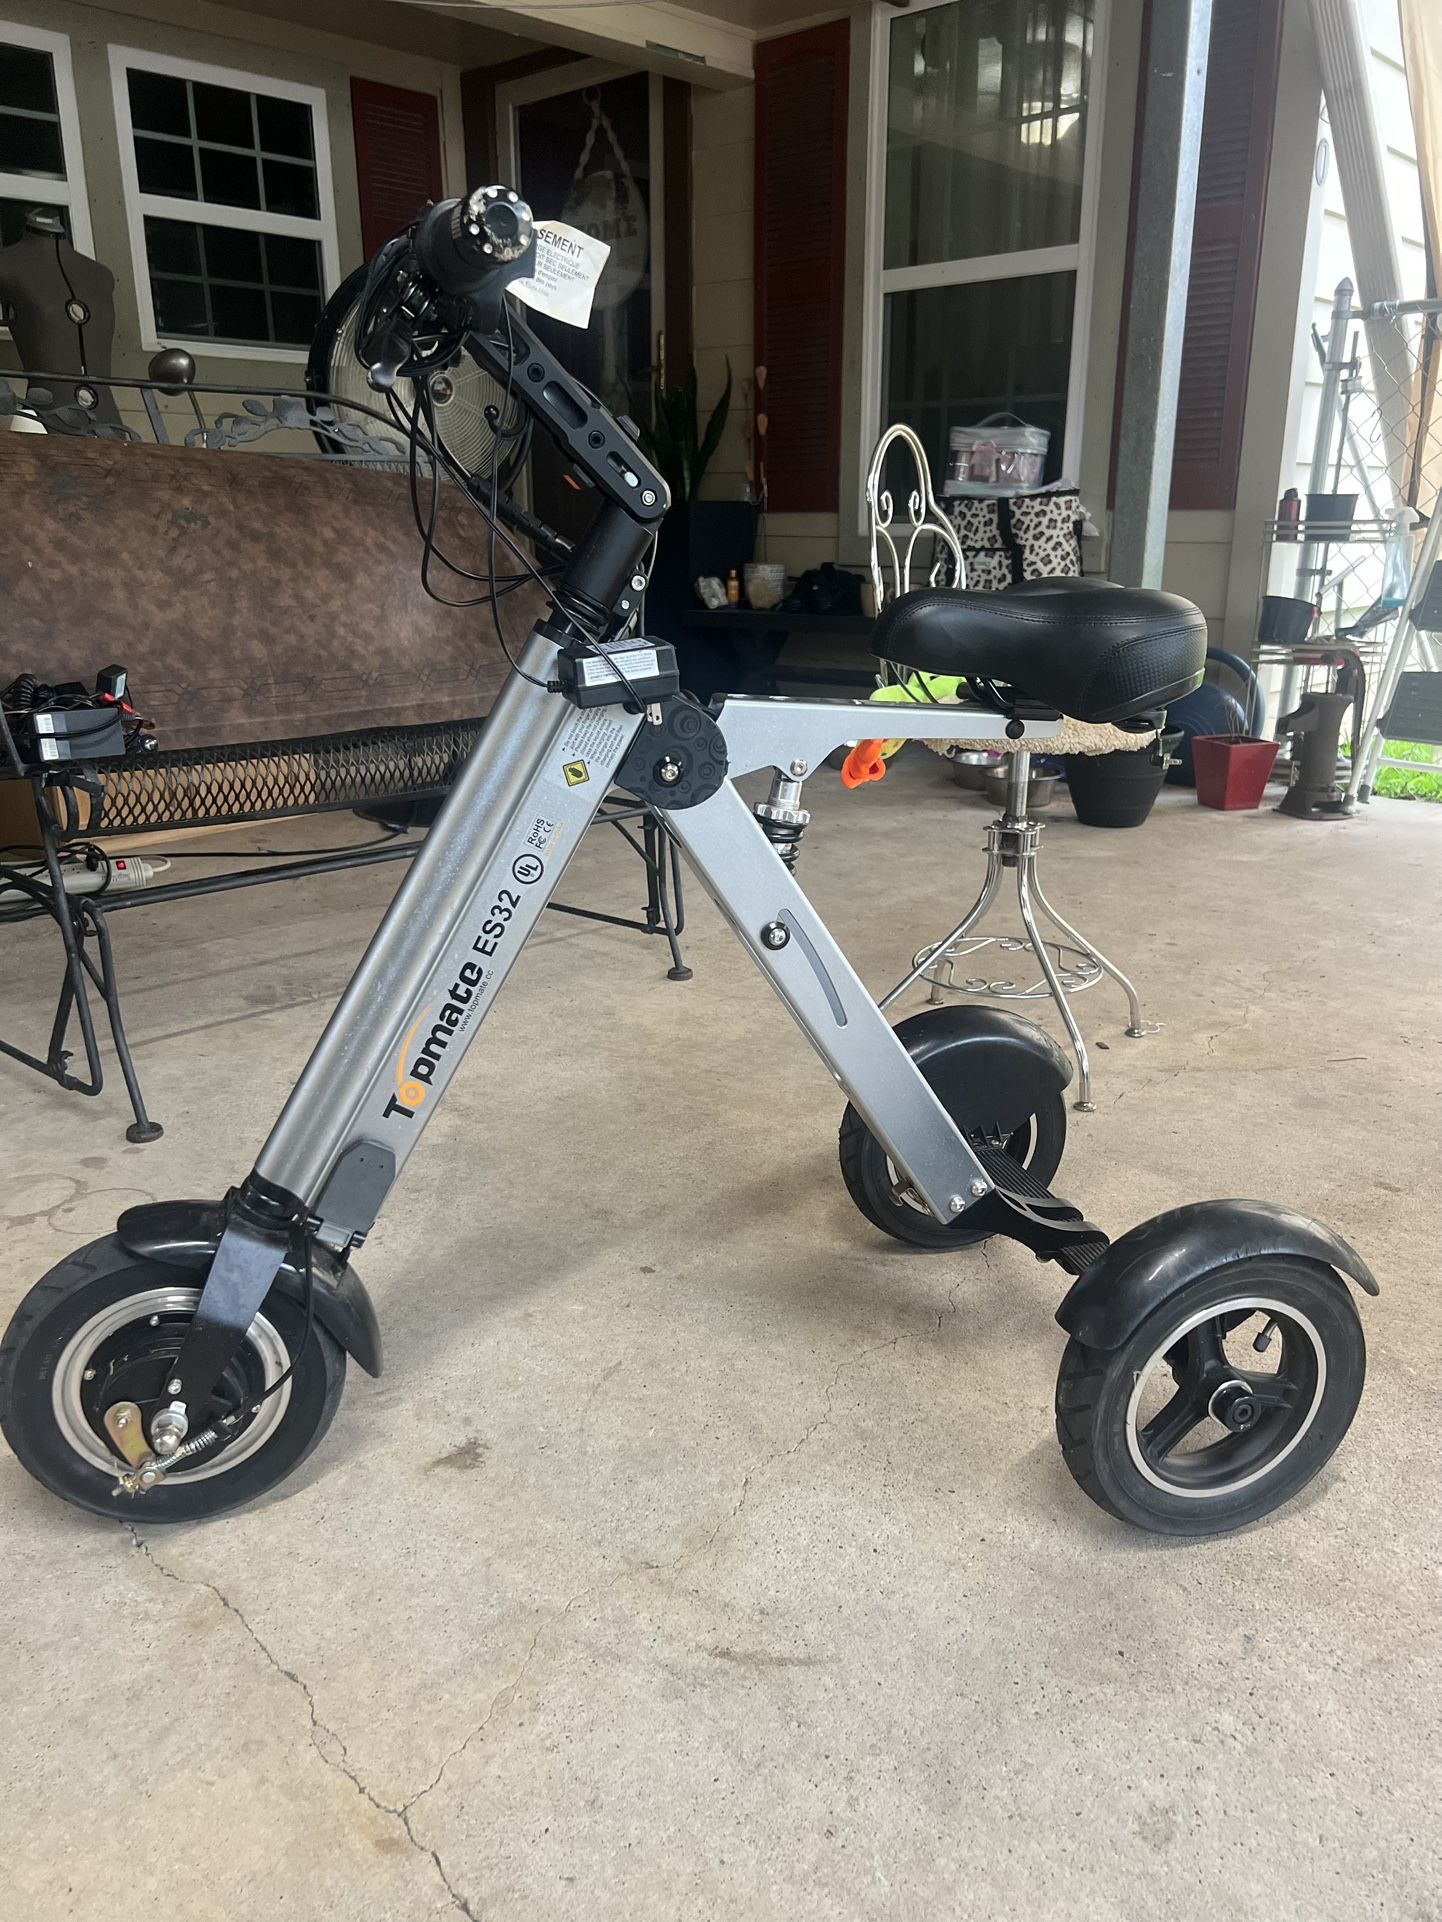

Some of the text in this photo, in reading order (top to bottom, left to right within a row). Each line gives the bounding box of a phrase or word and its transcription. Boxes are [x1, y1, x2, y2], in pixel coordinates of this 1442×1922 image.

[579, 214, 637, 240] OME
[537, 229, 584, 258] SEMENT
[527, 818, 545, 845] RoHS
[543, 820, 554, 833] CE
[517, 864, 539, 877] UL
[382, 889, 522, 1119] Topmate ES32
[459, 969, 494, 1032] www.topmate.cc
